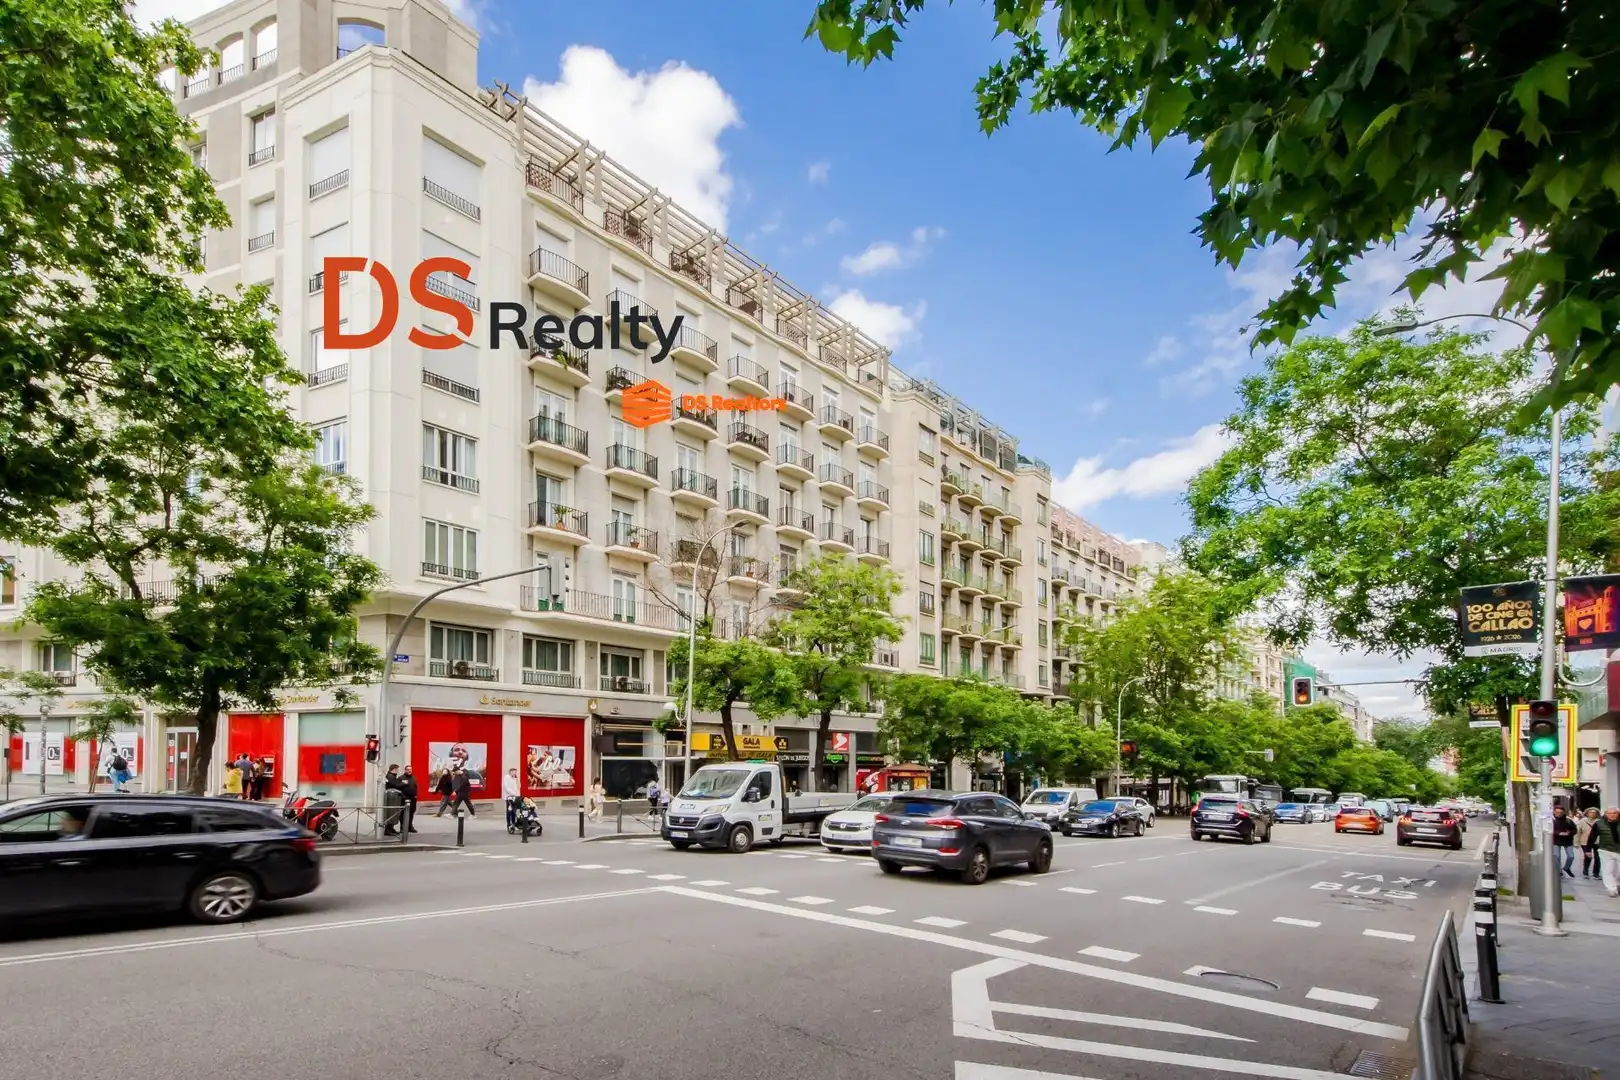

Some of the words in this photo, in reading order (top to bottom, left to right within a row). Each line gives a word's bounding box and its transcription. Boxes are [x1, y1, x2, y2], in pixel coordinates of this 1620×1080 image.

[1466, 603, 1493, 614] 100
[1496, 599, 1533, 611] AÑOS
[1467, 612, 1484, 622] DE
[1485, 610, 1514, 620] CINE
[1516, 609, 1533, 617] EN
[1468, 617, 1534, 633] CALLAO
[286, 695, 319, 704] Santander
[491, 697, 532, 707] Santander
[742, 737, 761, 746] GALA
[1341, 871, 1437, 888] TAXI
[1309, 881, 1419, 899] BUS
